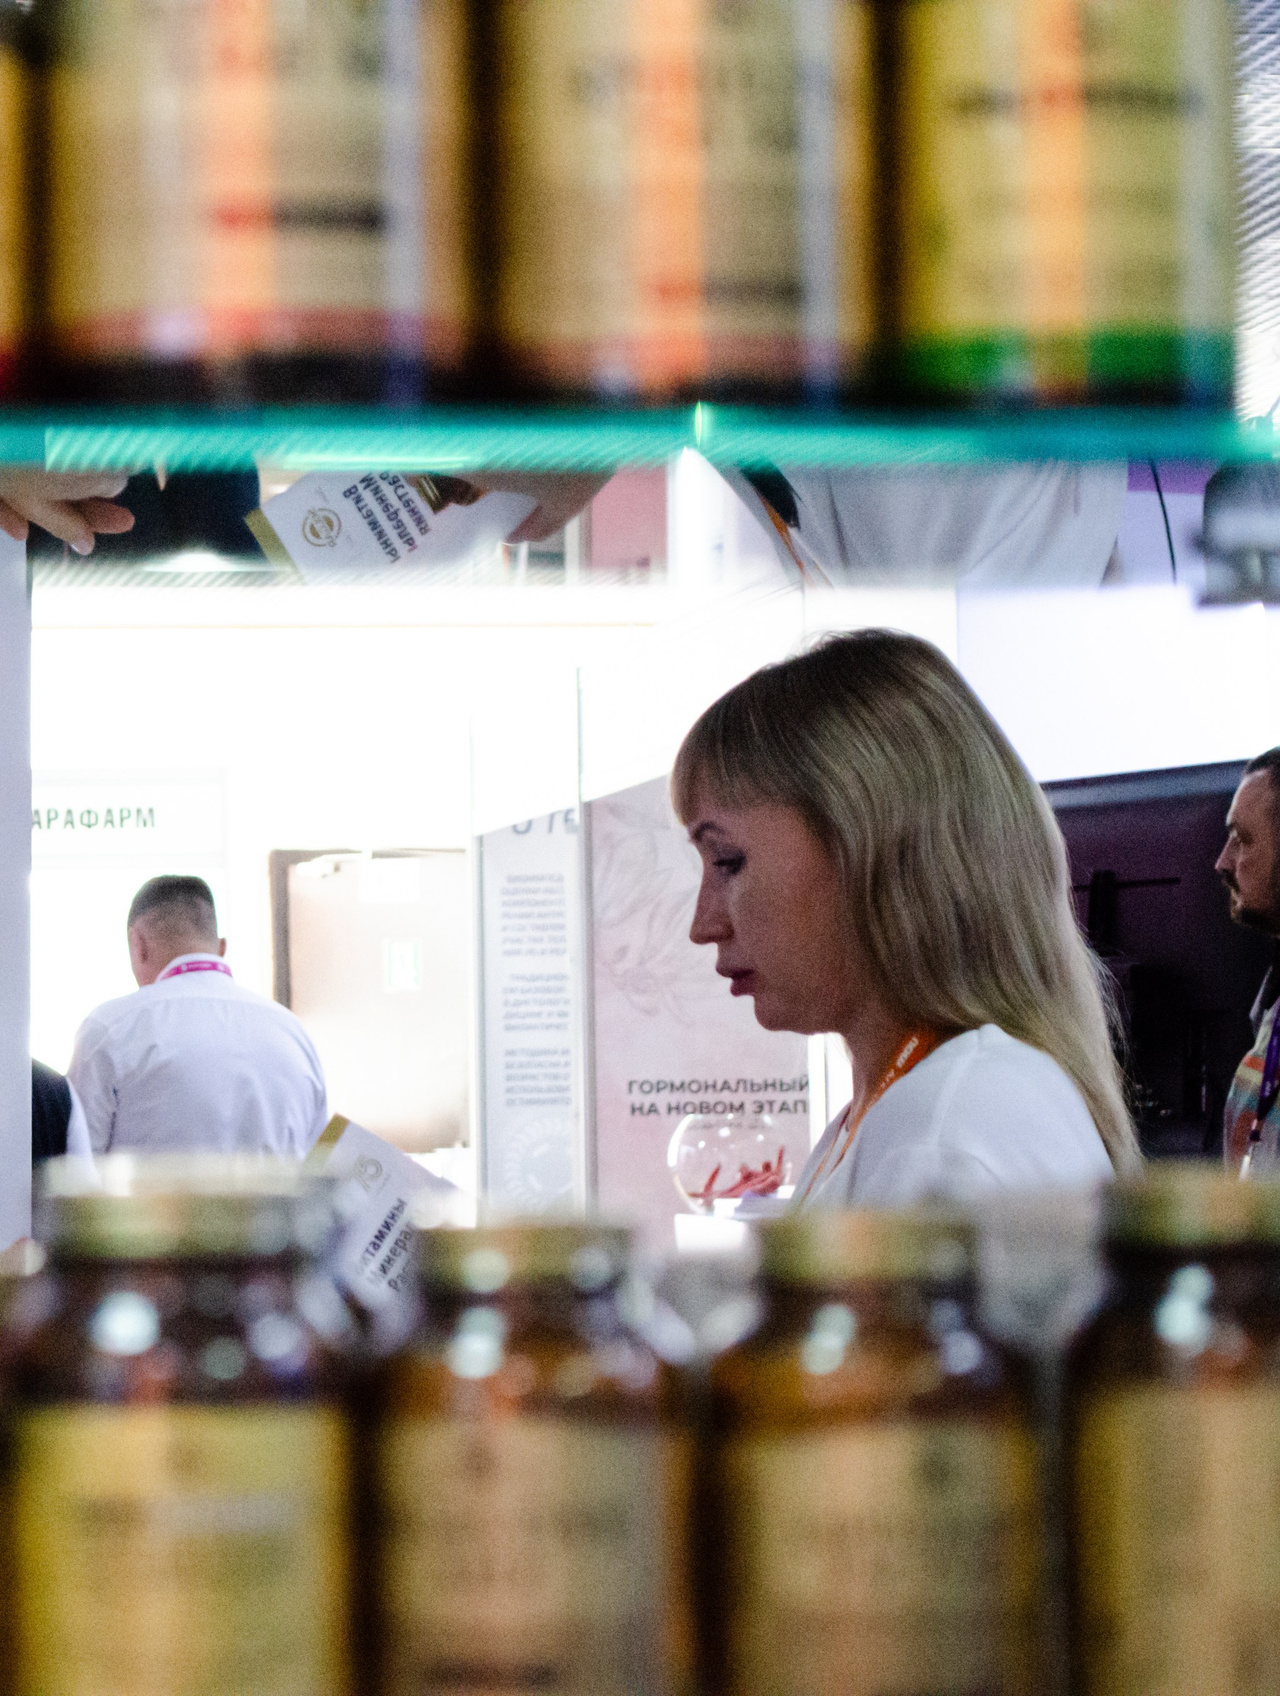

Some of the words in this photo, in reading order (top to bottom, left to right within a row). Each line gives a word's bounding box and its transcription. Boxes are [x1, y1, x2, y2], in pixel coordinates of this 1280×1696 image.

[31, 807, 155, 829] АРАФАРМ
[628, 1074, 810, 1094] ГОРМОНАЛЬНЫЙ
[630, 1102, 660, 1116] НА
[667, 1101, 745, 1116] НОВОМ
[753, 1100, 808, 1115] ЭТАП
